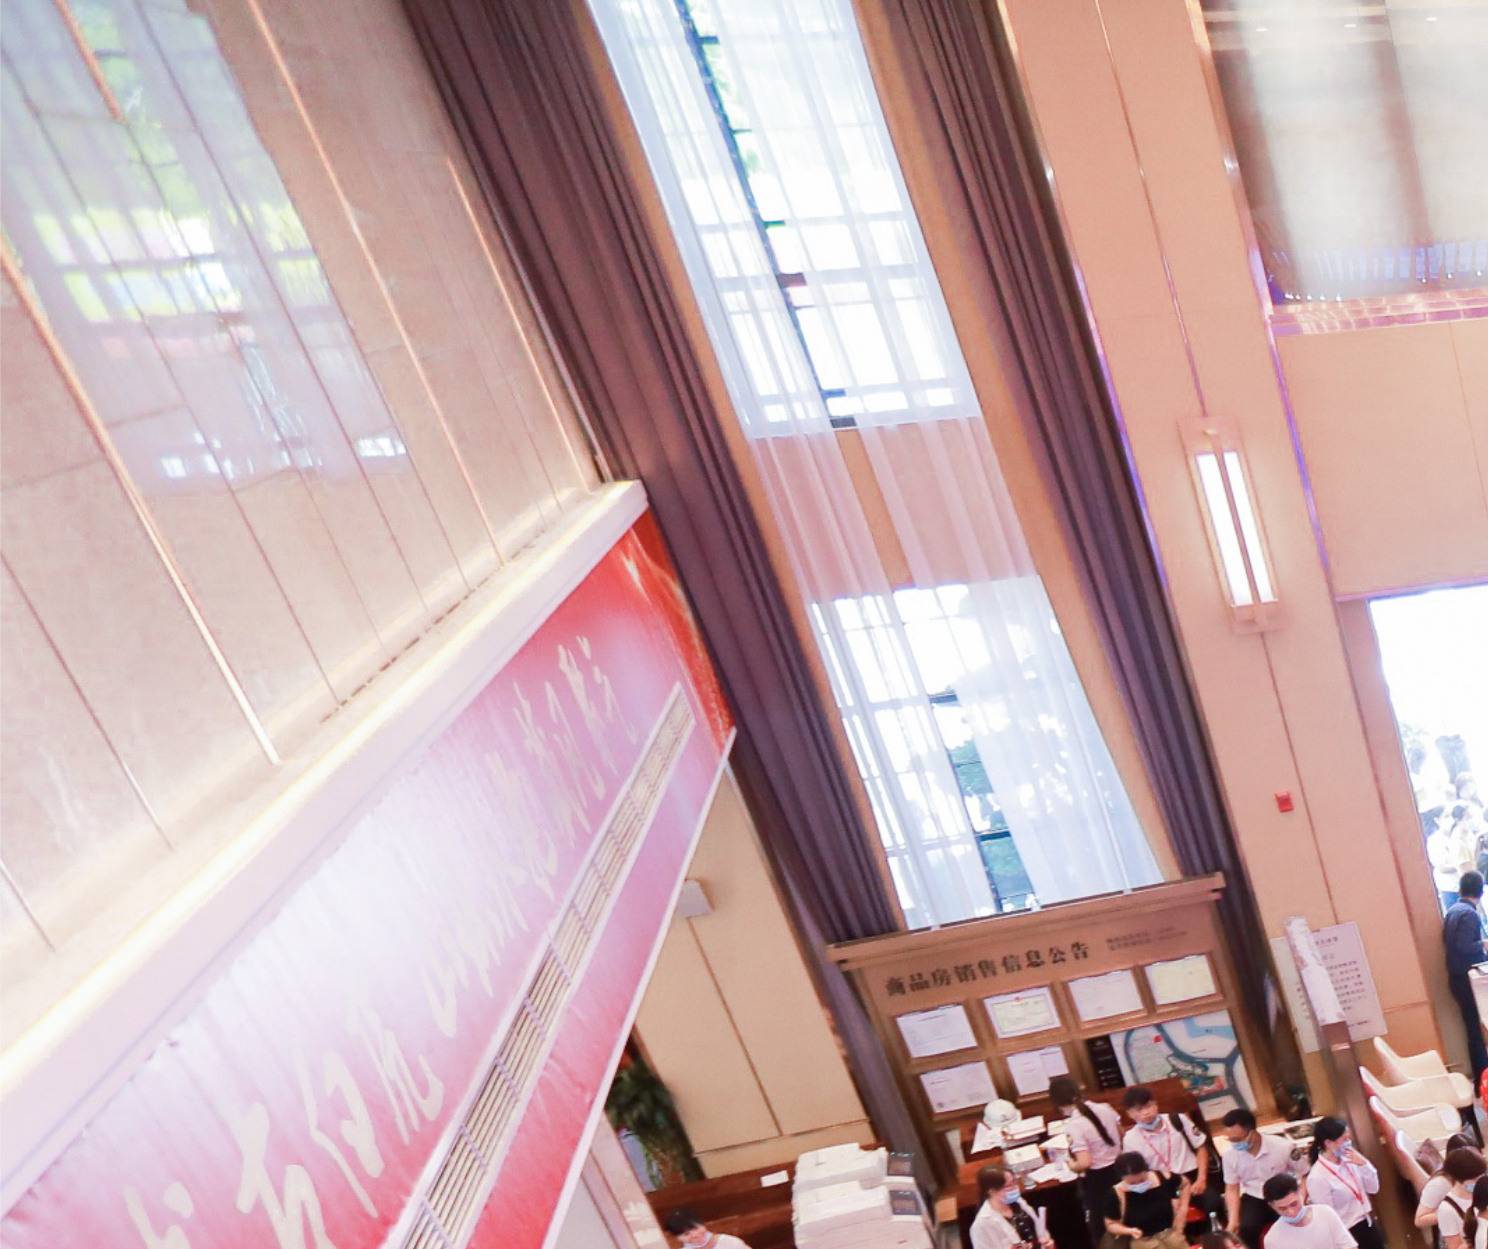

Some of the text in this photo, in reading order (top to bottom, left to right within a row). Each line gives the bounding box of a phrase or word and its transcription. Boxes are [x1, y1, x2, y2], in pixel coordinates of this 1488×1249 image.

[886, 942, 1091, 997] 商品房销售信息公告
